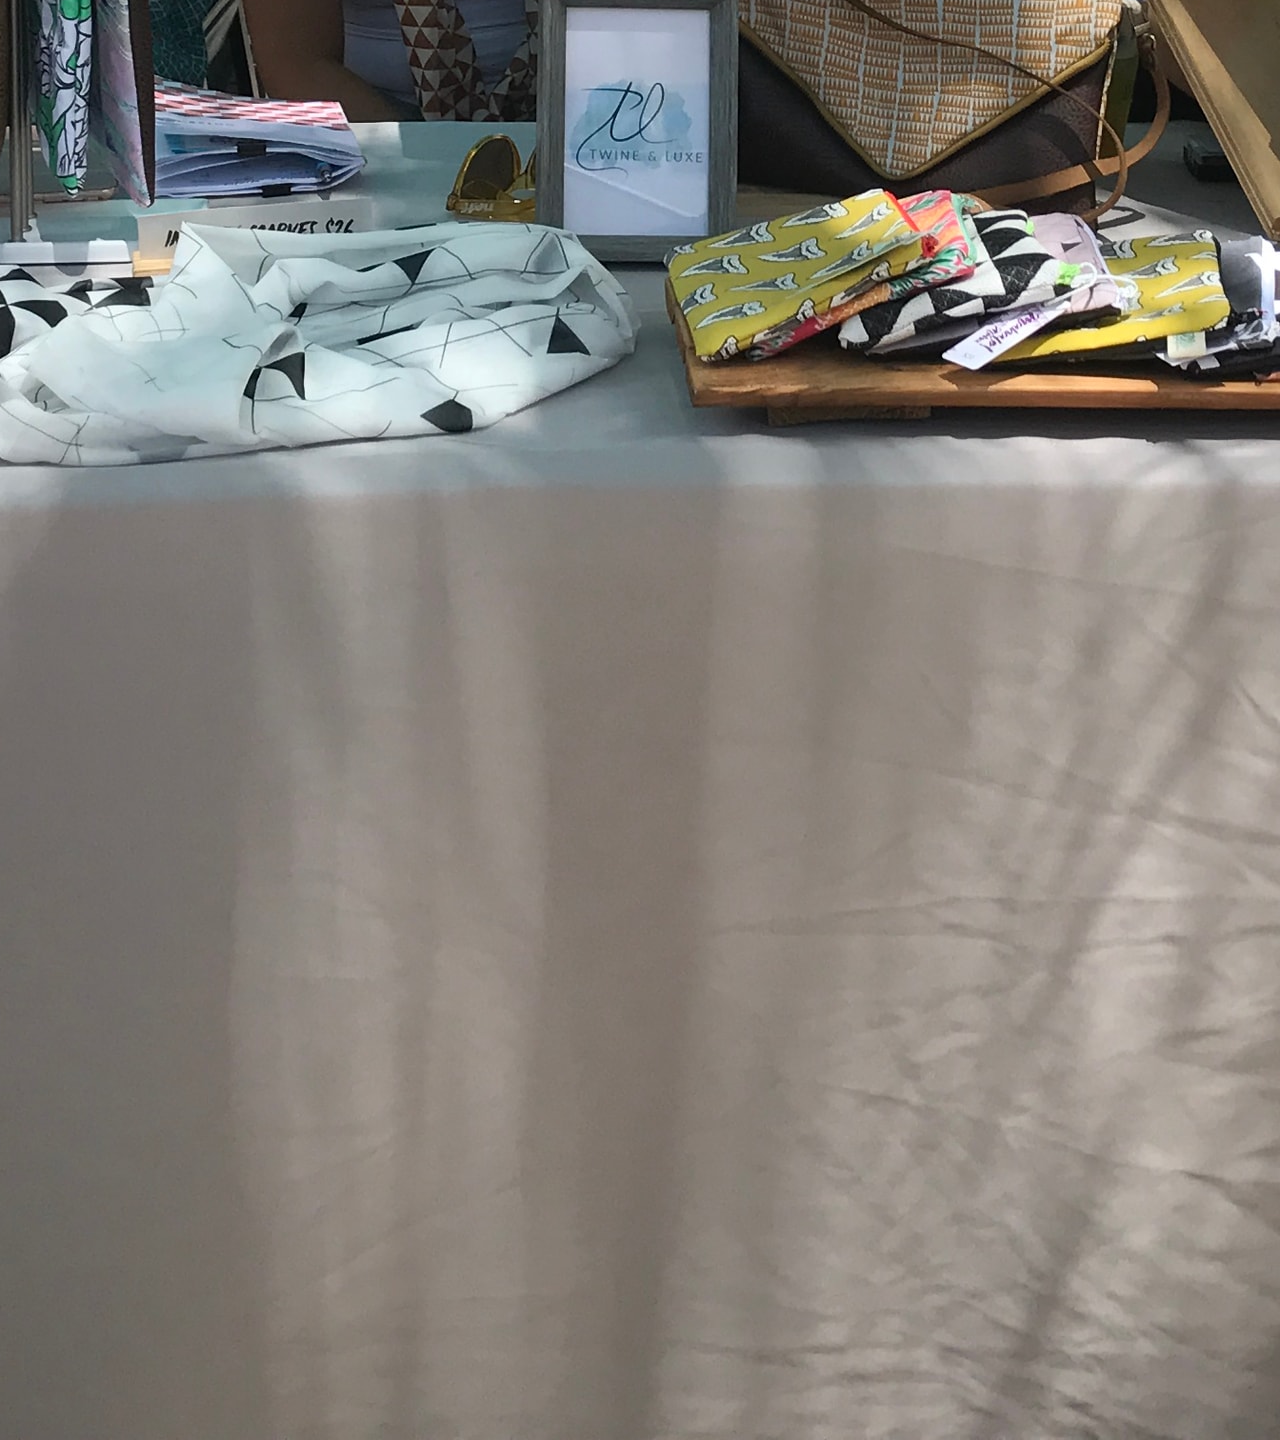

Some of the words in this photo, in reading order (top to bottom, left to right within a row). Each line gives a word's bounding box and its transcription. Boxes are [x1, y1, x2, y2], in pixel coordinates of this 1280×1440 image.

[590, 148, 640, 161] TWINE
[647, 150, 657, 162] &
[665, 152, 703, 164] LUXE
